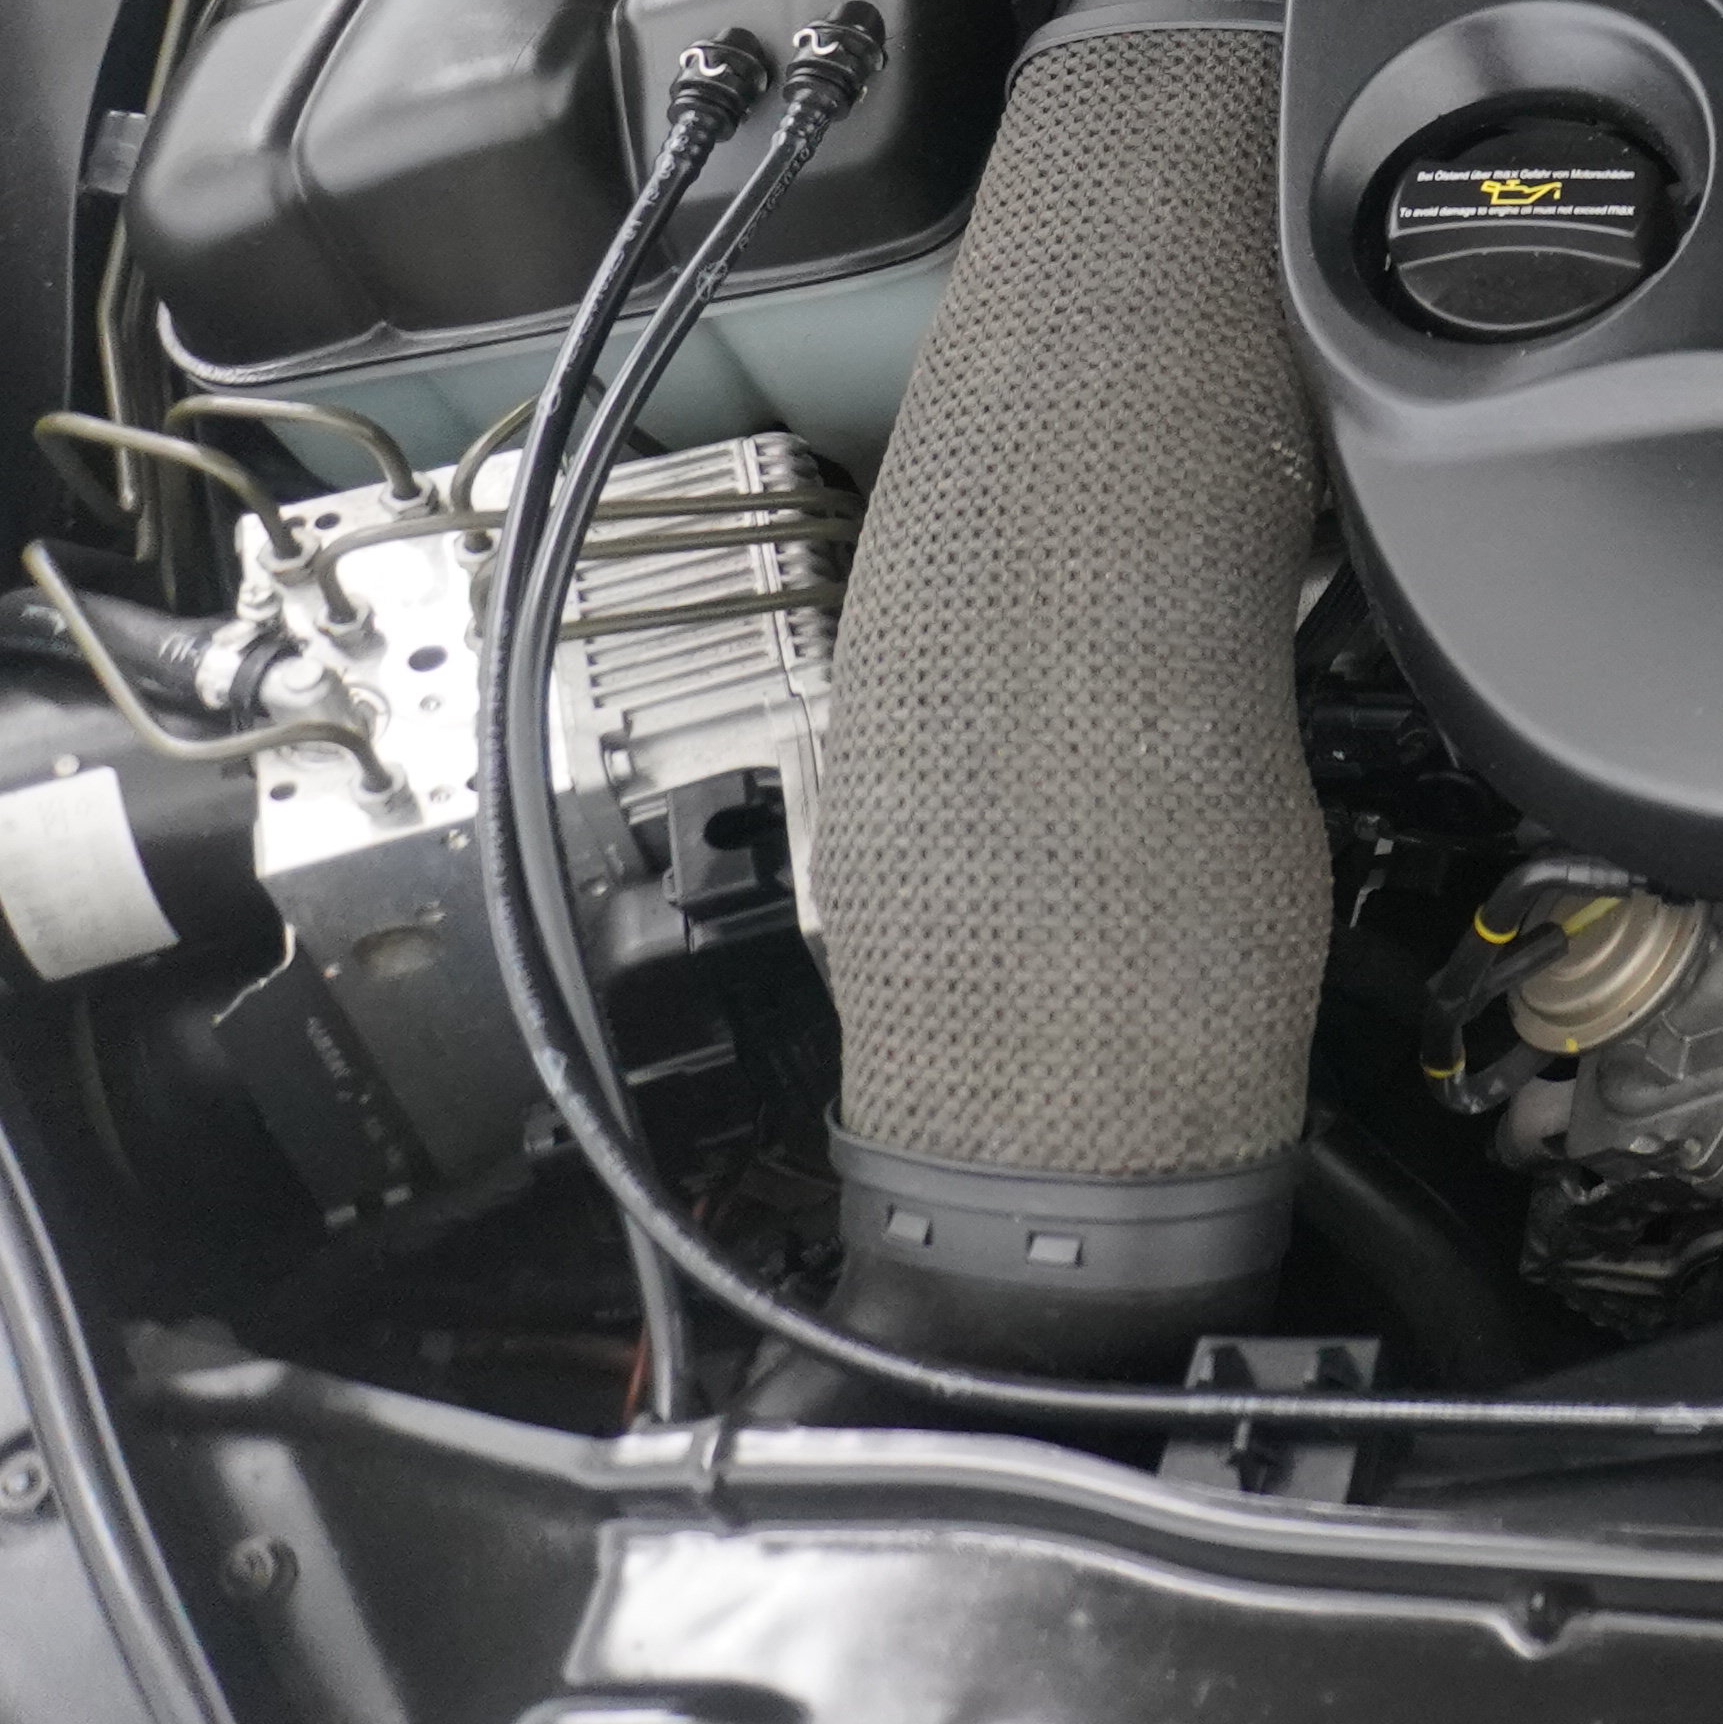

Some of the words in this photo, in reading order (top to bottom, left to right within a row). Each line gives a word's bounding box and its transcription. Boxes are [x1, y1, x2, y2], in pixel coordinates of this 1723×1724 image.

[1417, 171, 1434, 182] Bei
[1493, 169, 1519, 180] max
[1519, 168, 1552, 180] Gefahr
[1552, 170, 1571, 180] von
[1400, 207, 1413, 218] To
[1413, 206, 1439, 218] avoid
[1439, 206, 1476, 218] damage
[1477, 206, 1488, 216] to
[1488, 206, 1520, 217] engine
[1520, 205, 1533, 215] oil
[1533, 205, 1557, 215] must
[1556, 205, 1574, 215] not
[1573, 205, 1608, 216] exceed
[1607, 205, 1636, 216] max
